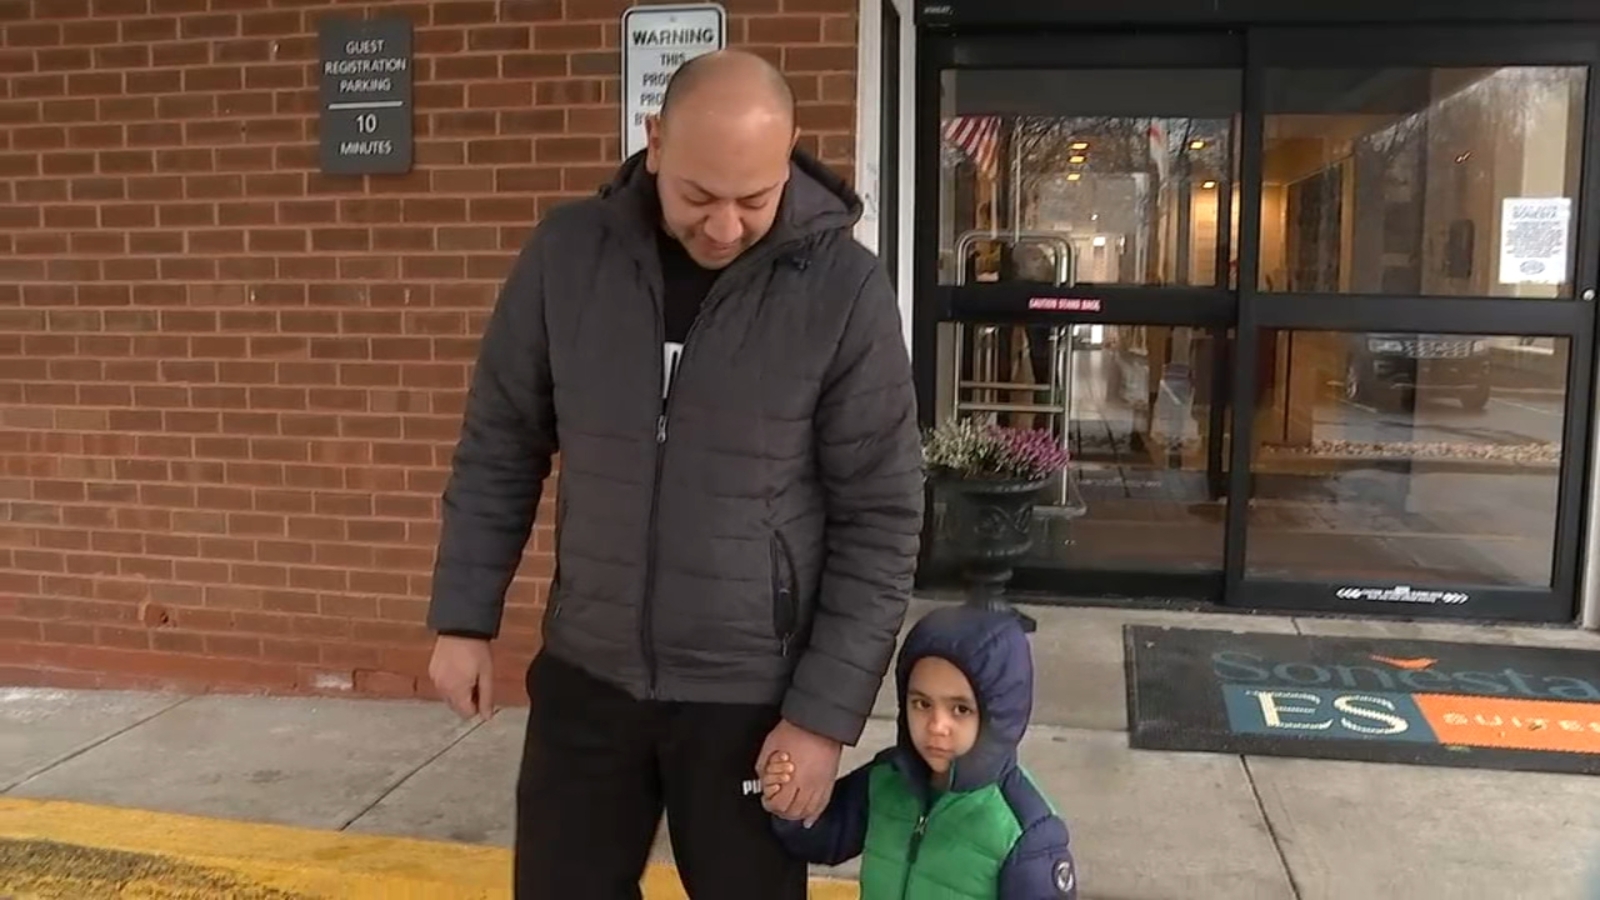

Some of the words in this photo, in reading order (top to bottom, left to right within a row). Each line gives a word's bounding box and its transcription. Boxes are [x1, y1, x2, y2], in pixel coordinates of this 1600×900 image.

[632, 28, 715, 46] WARNING
[345, 39, 385, 54] GUEST
[324, 58, 407, 75] REGISTRATION
[660, 52, 686, 67] THIS
[339, 77, 391, 93] PARKING
[640, 92, 666, 107] PRO
[356, 113, 377, 133] 10
[339, 140, 392, 156] MINUTES
[1211, 650, 1600, 699] Sonesta
[1245, 689, 1410, 735] ES
[742, 779, 762, 796] PU
